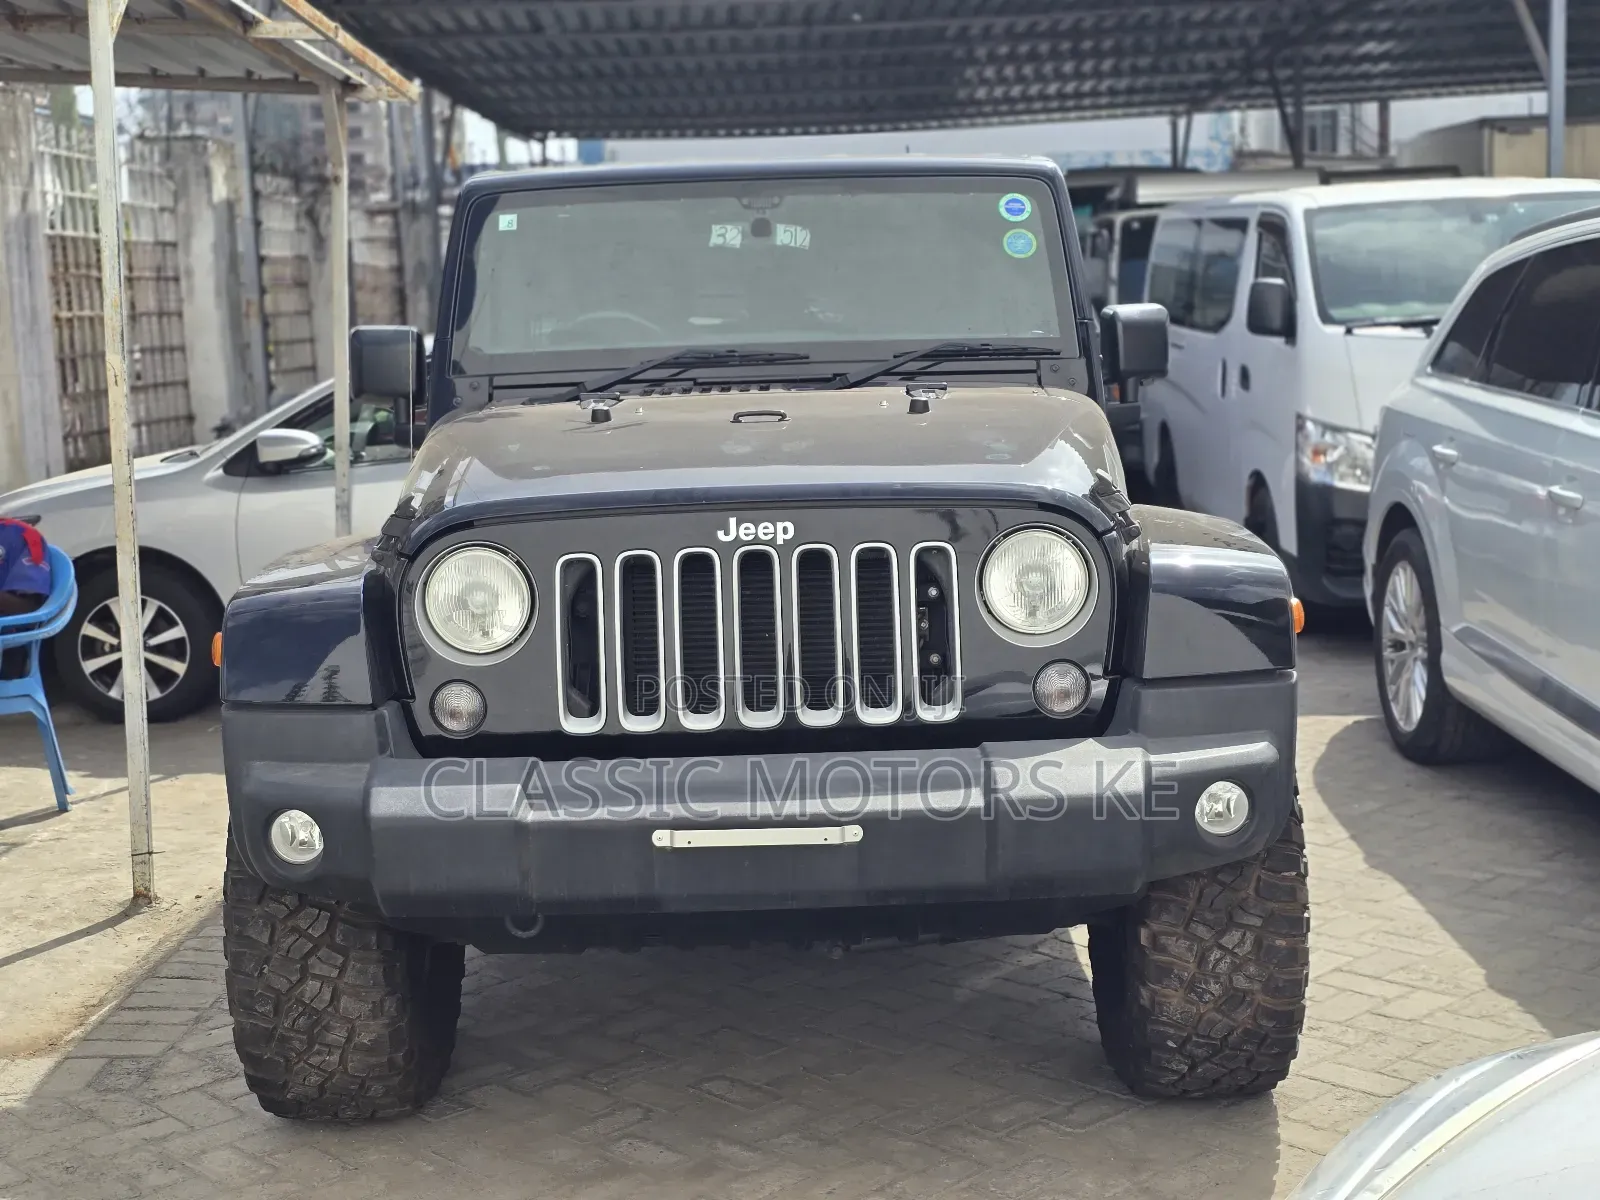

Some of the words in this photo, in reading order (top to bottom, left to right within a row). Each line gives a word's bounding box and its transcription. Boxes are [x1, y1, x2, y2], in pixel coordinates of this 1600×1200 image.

[715, 225, 741, 246] 32
[779, 226, 809, 248] 512
[717, 516, 795, 545] Jeep
